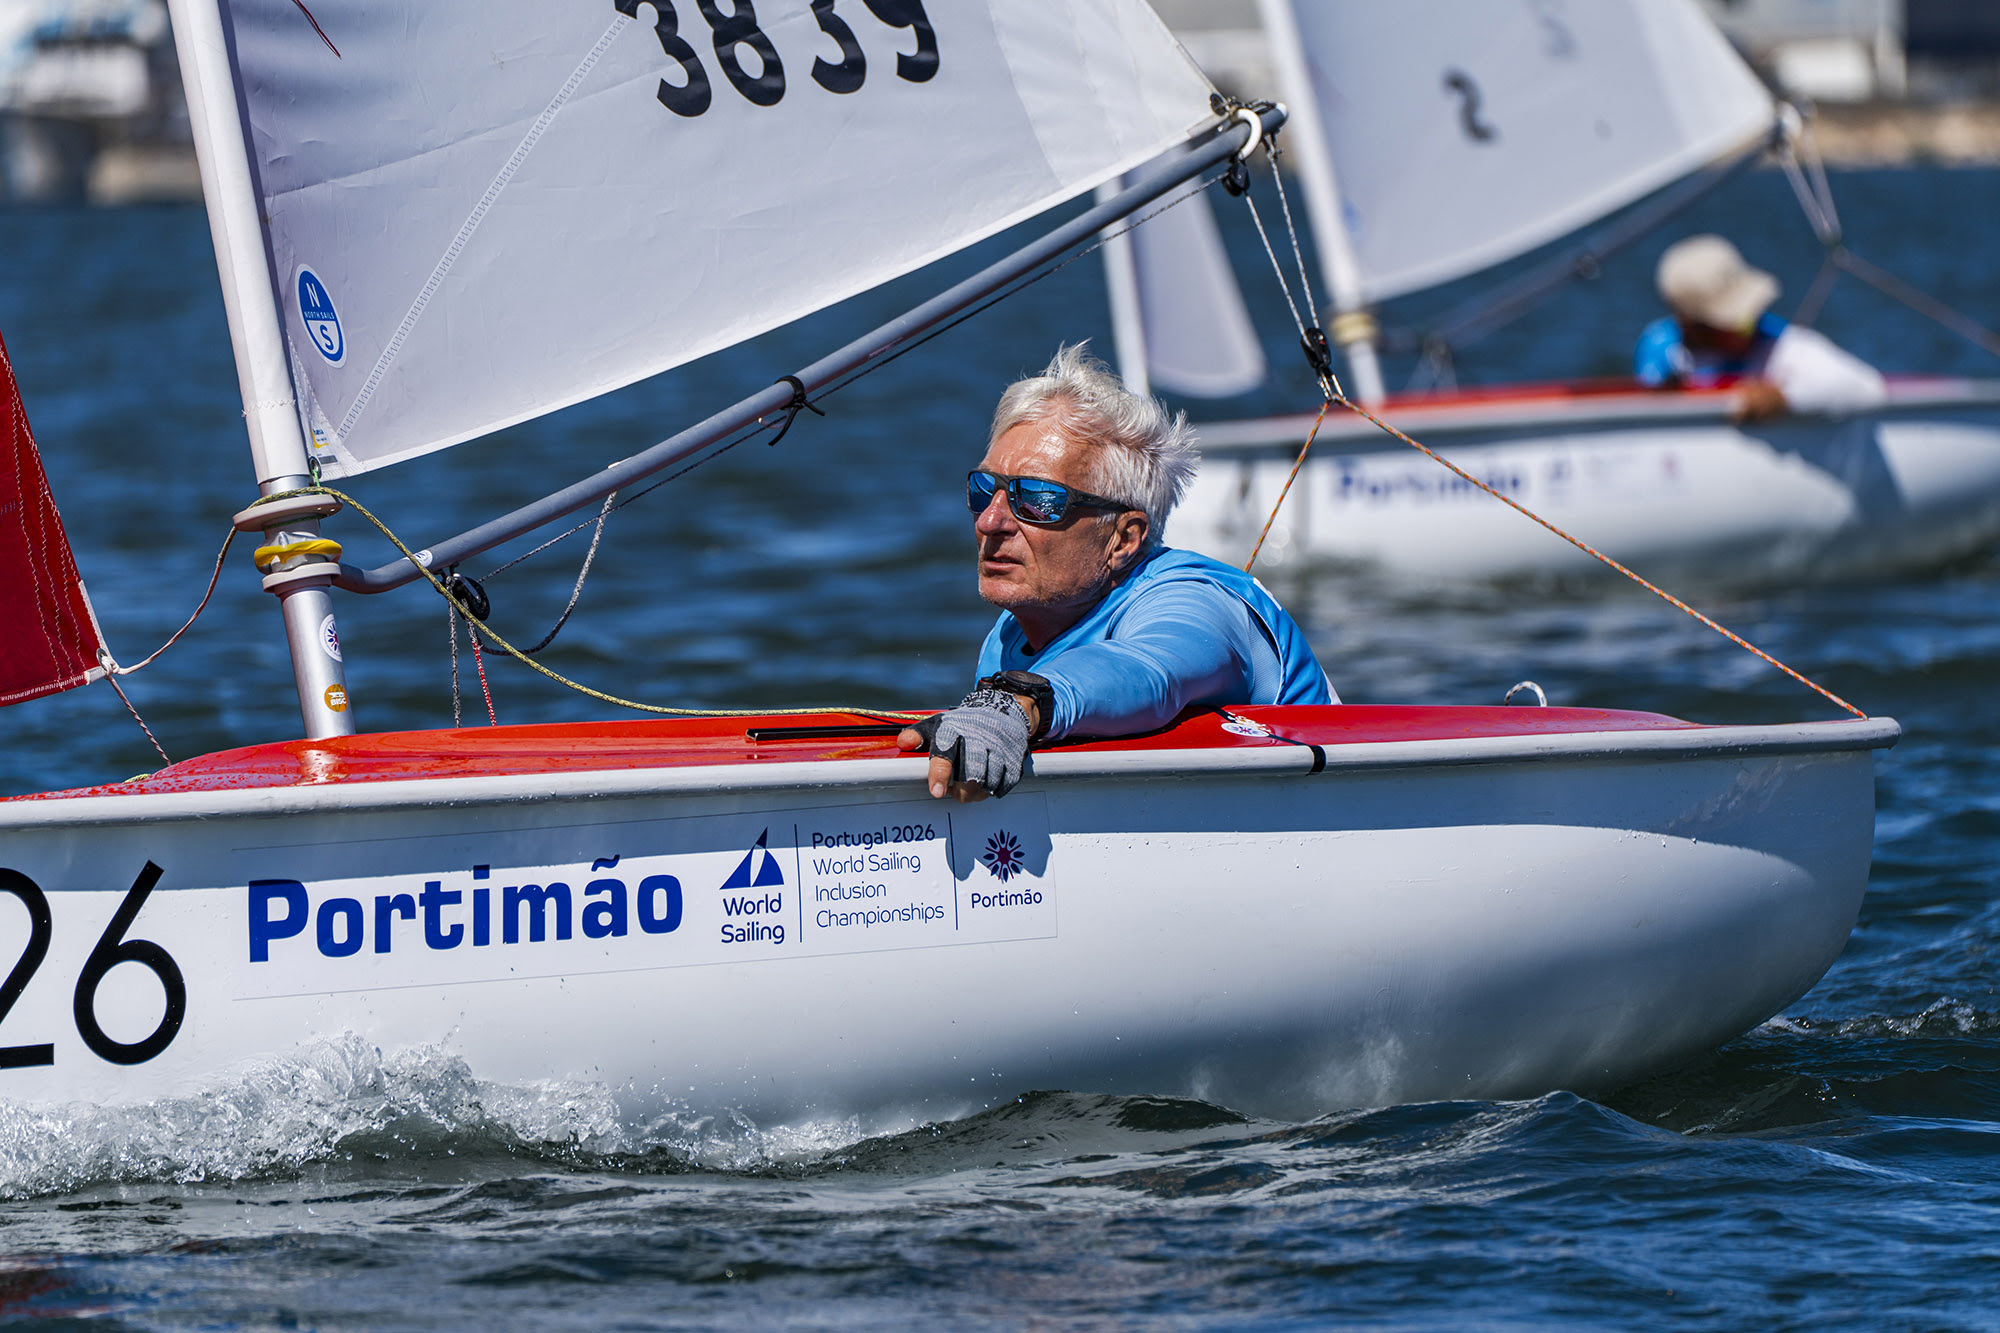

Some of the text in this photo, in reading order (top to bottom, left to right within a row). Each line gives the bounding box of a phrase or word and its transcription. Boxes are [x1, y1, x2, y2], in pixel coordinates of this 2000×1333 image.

[305, 282, 320, 308] N
[304, 311, 335, 320] NORTH SAILS
[320, 324, 334, 351] S
[812, 823, 936, 850] Portugal 2026
[813, 852, 921, 876] World Sailing
[815, 881, 887, 902] Inclusion
[971, 888, 1043, 909] Portimão
[248, 854, 684, 963] Portimão
[722, 892, 782, 917] World
[816, 902, 945, 929] Championships
[720, 921, 785, 945] Sailing
